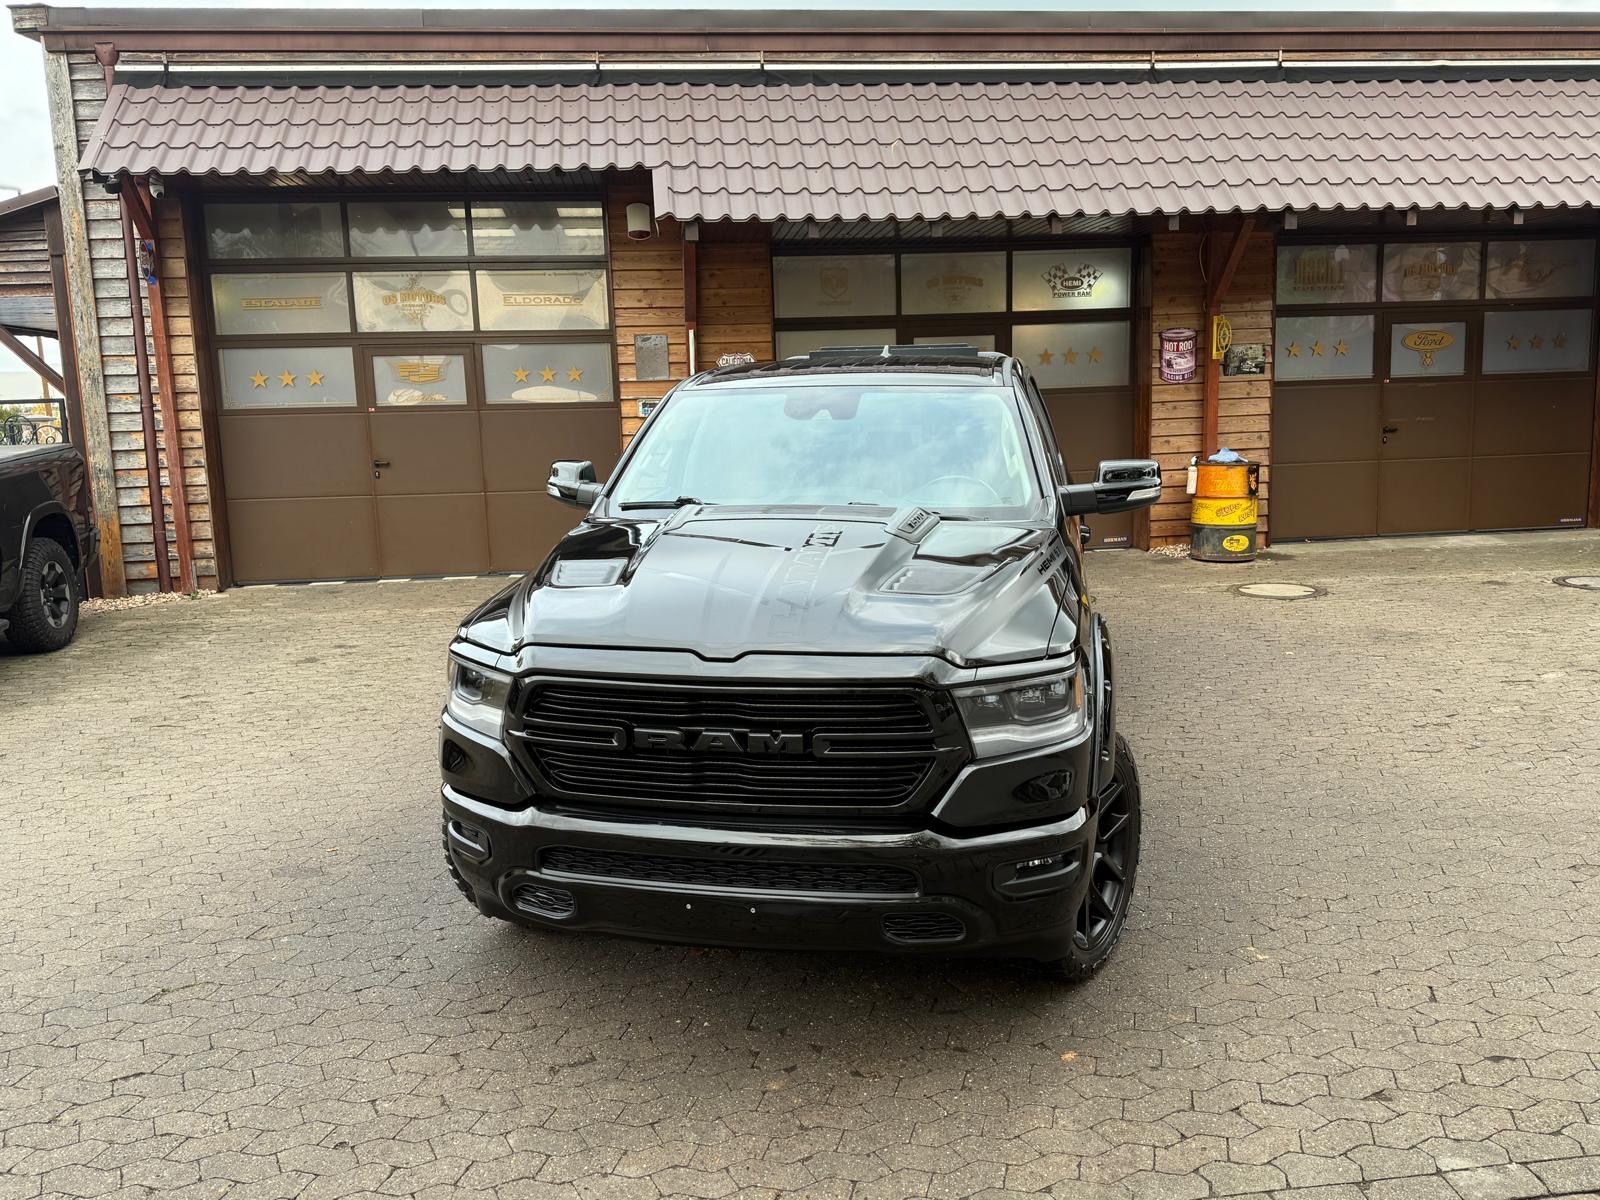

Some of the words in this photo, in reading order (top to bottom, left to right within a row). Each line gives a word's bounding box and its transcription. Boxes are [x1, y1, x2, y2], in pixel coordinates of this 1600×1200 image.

[502, 295, 582, 305] ELDORADO
[1164, 340, 1178, 352] HOT
[1179, 340, 1193, 352] ROD
[1414, 333, 1445, 346] Ford
[1037, 551, 1057, 576] HEMI
[633, 727, 804, 753] RAM
